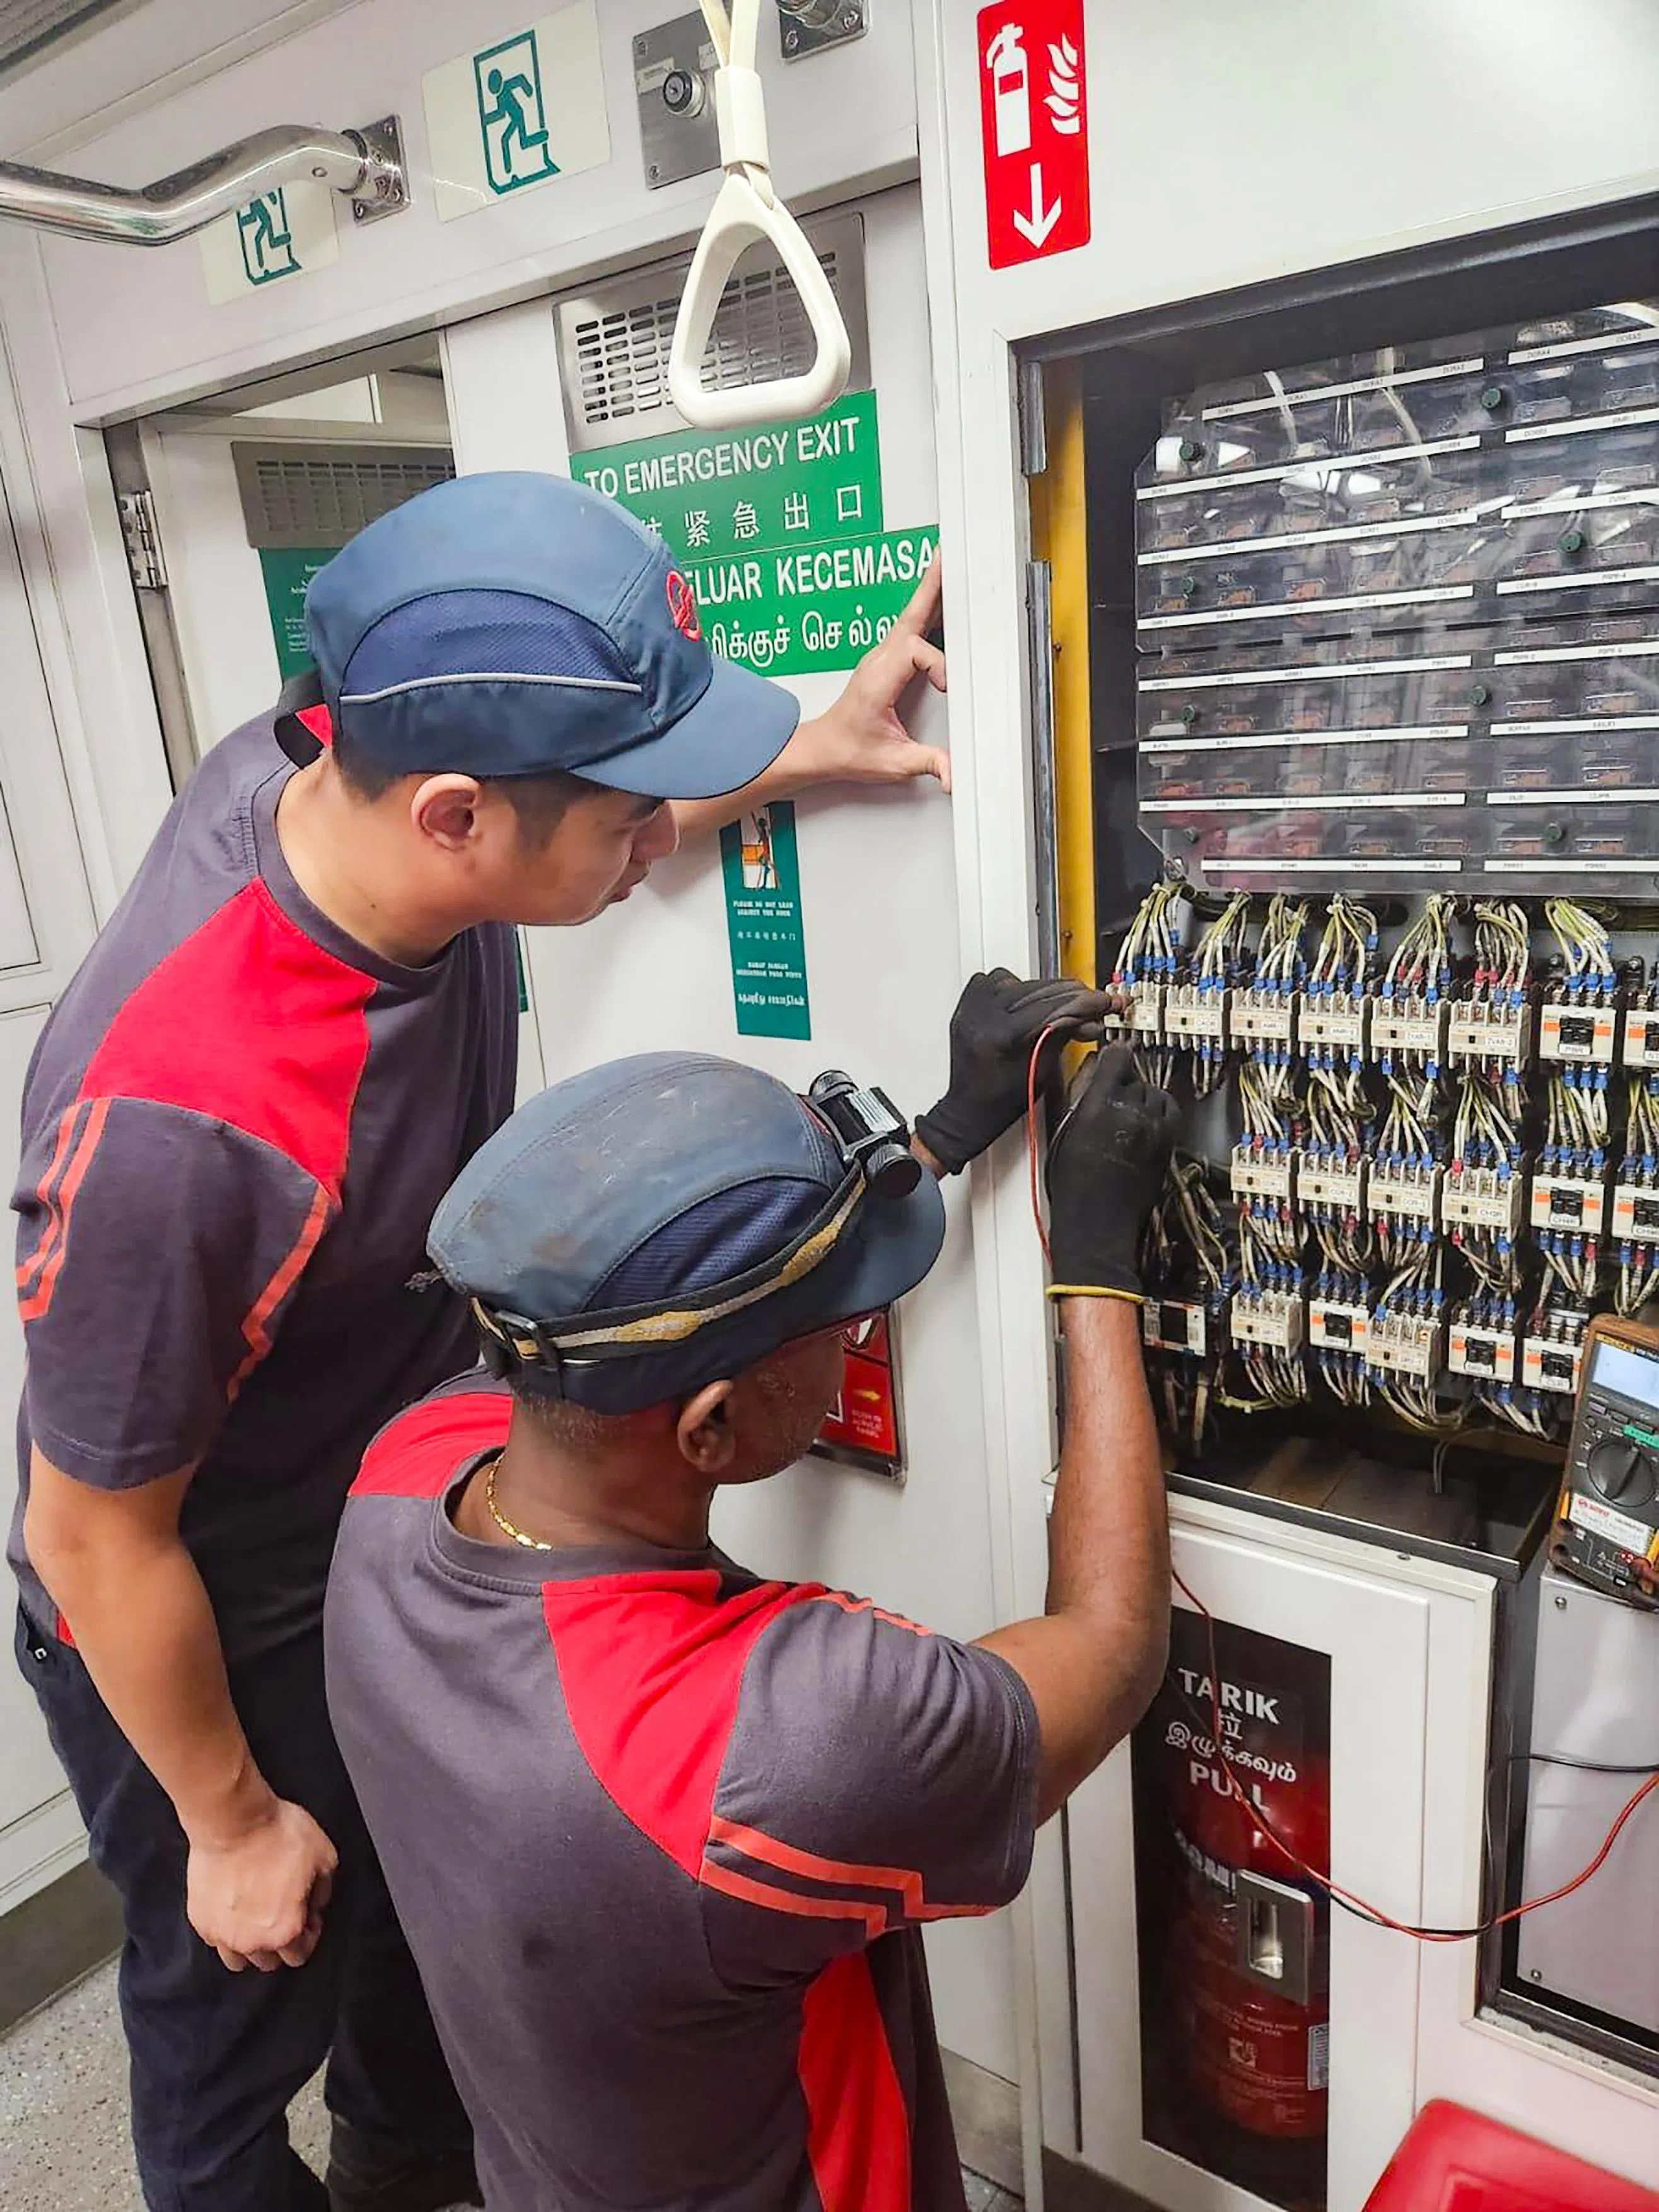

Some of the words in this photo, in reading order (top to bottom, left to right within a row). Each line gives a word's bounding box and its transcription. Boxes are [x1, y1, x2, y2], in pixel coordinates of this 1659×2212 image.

[585, 467, 619, 499] TO
[624, 432, 789, 494] EMERGENCY
[797, 417, 859, 462] EXIT
[1177, 1667, 1280, 1725] TARIK
[1189, 1761, 1271, 1814] PUL
